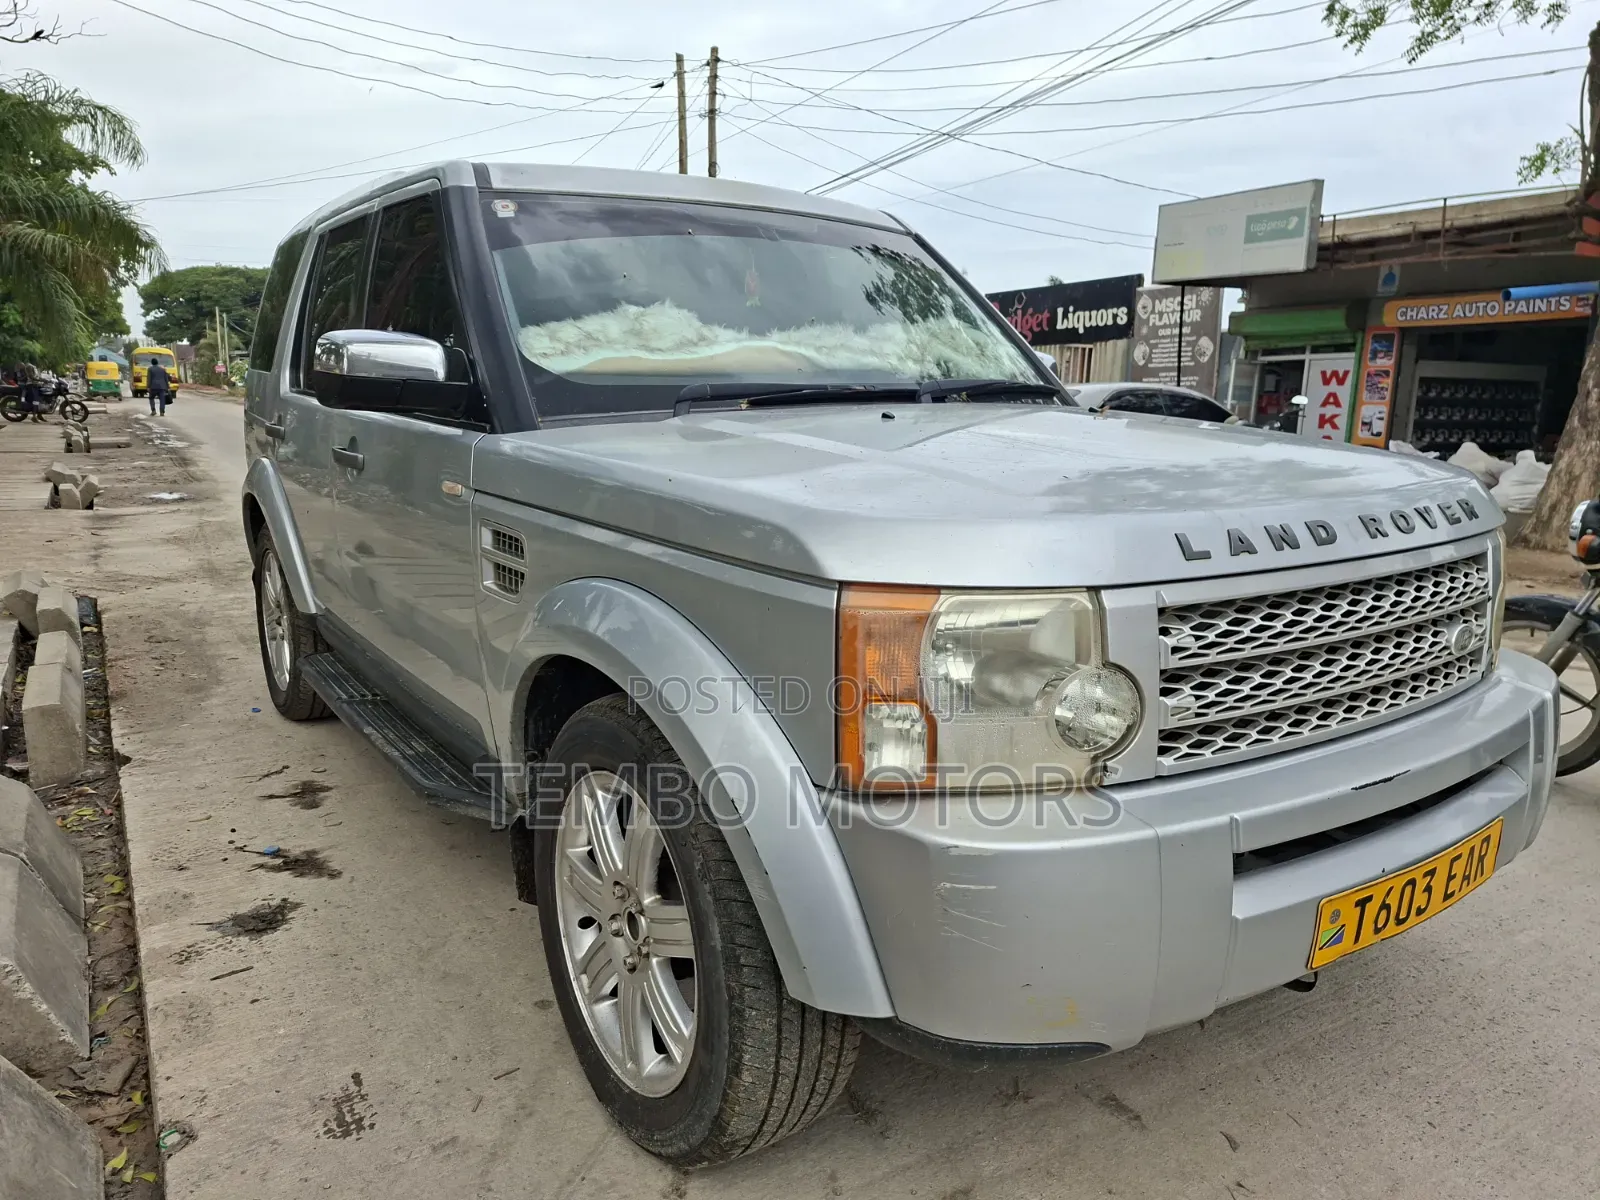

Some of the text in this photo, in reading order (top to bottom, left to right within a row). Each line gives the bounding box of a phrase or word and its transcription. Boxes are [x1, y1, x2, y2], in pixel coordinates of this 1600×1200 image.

[1056, 305, 1128, 334] Liquors
[1396, 303, 1448, 321] CHARZ
[1452, 301, 1499, 318] AUTO
[1504, 295, 1571, 314] PAINTS
[1318, 369, 1350, 440] WAK
[1174, 498, 1480, 561] LAND ROVER
[1353, 833, 1492, 945] T603 EAR
